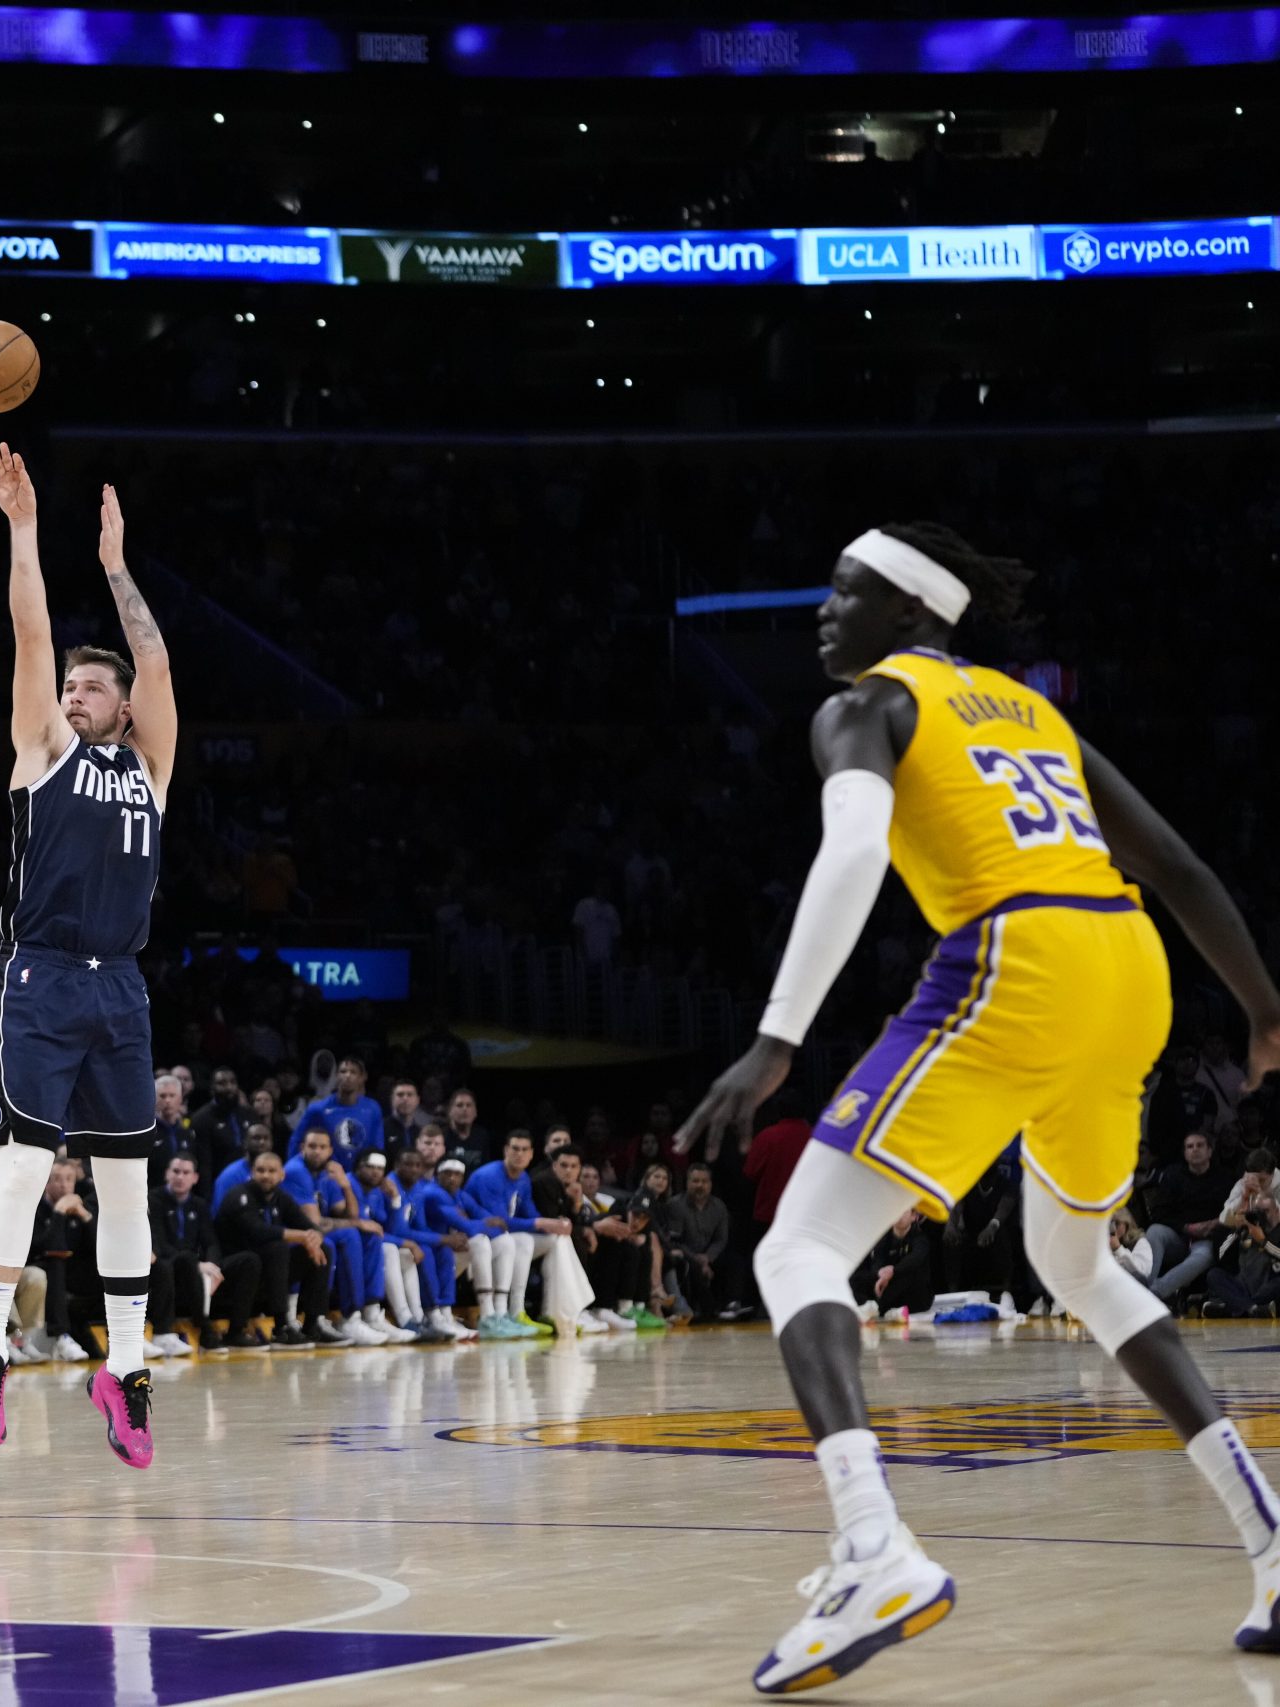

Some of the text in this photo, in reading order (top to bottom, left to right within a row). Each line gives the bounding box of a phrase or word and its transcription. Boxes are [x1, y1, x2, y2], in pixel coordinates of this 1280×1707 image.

[115, 242, 321, 265] AMERICAN EXPRESS
[589, 238, 764, 280] Spectrum
[828, 241, 1020, 268] UCLA Health
[1105, 233, 1250, 262] crypto.com
[965, 745, 1110, 854] 35
[121, 808, 150, 857] 17
